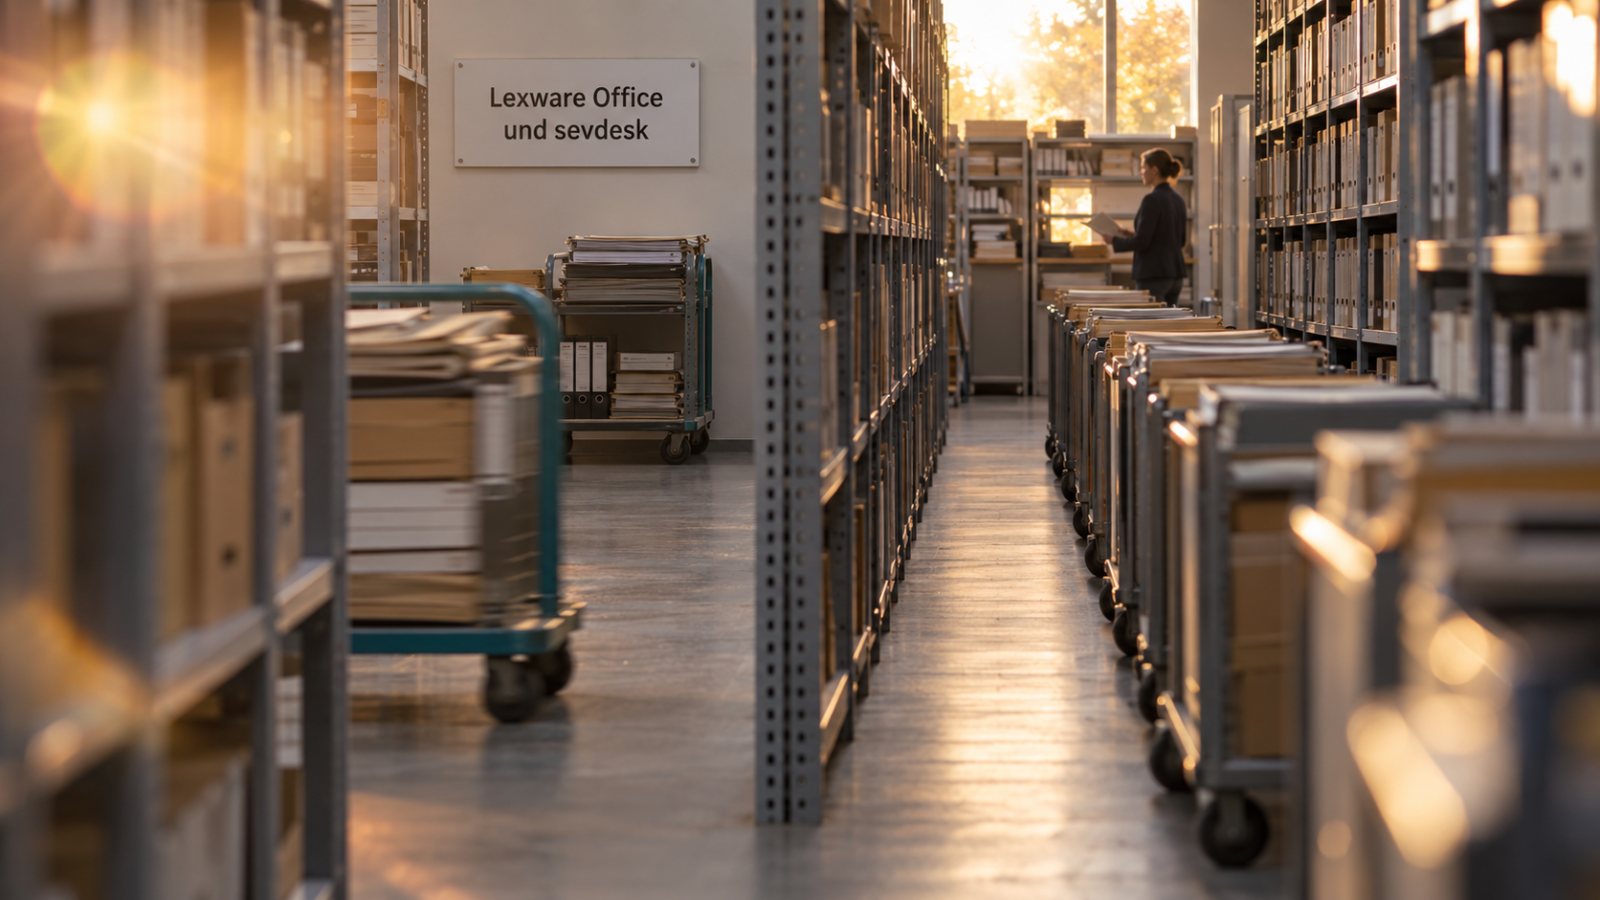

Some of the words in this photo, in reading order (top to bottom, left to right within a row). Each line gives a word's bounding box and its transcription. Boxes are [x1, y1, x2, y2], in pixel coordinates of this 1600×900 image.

[490, 86, 586, 108] Lexware
[593, 86, 663, 108] Office
[504, 118, 547, 140] und
[554, 118, 649, 140] sevdesk
